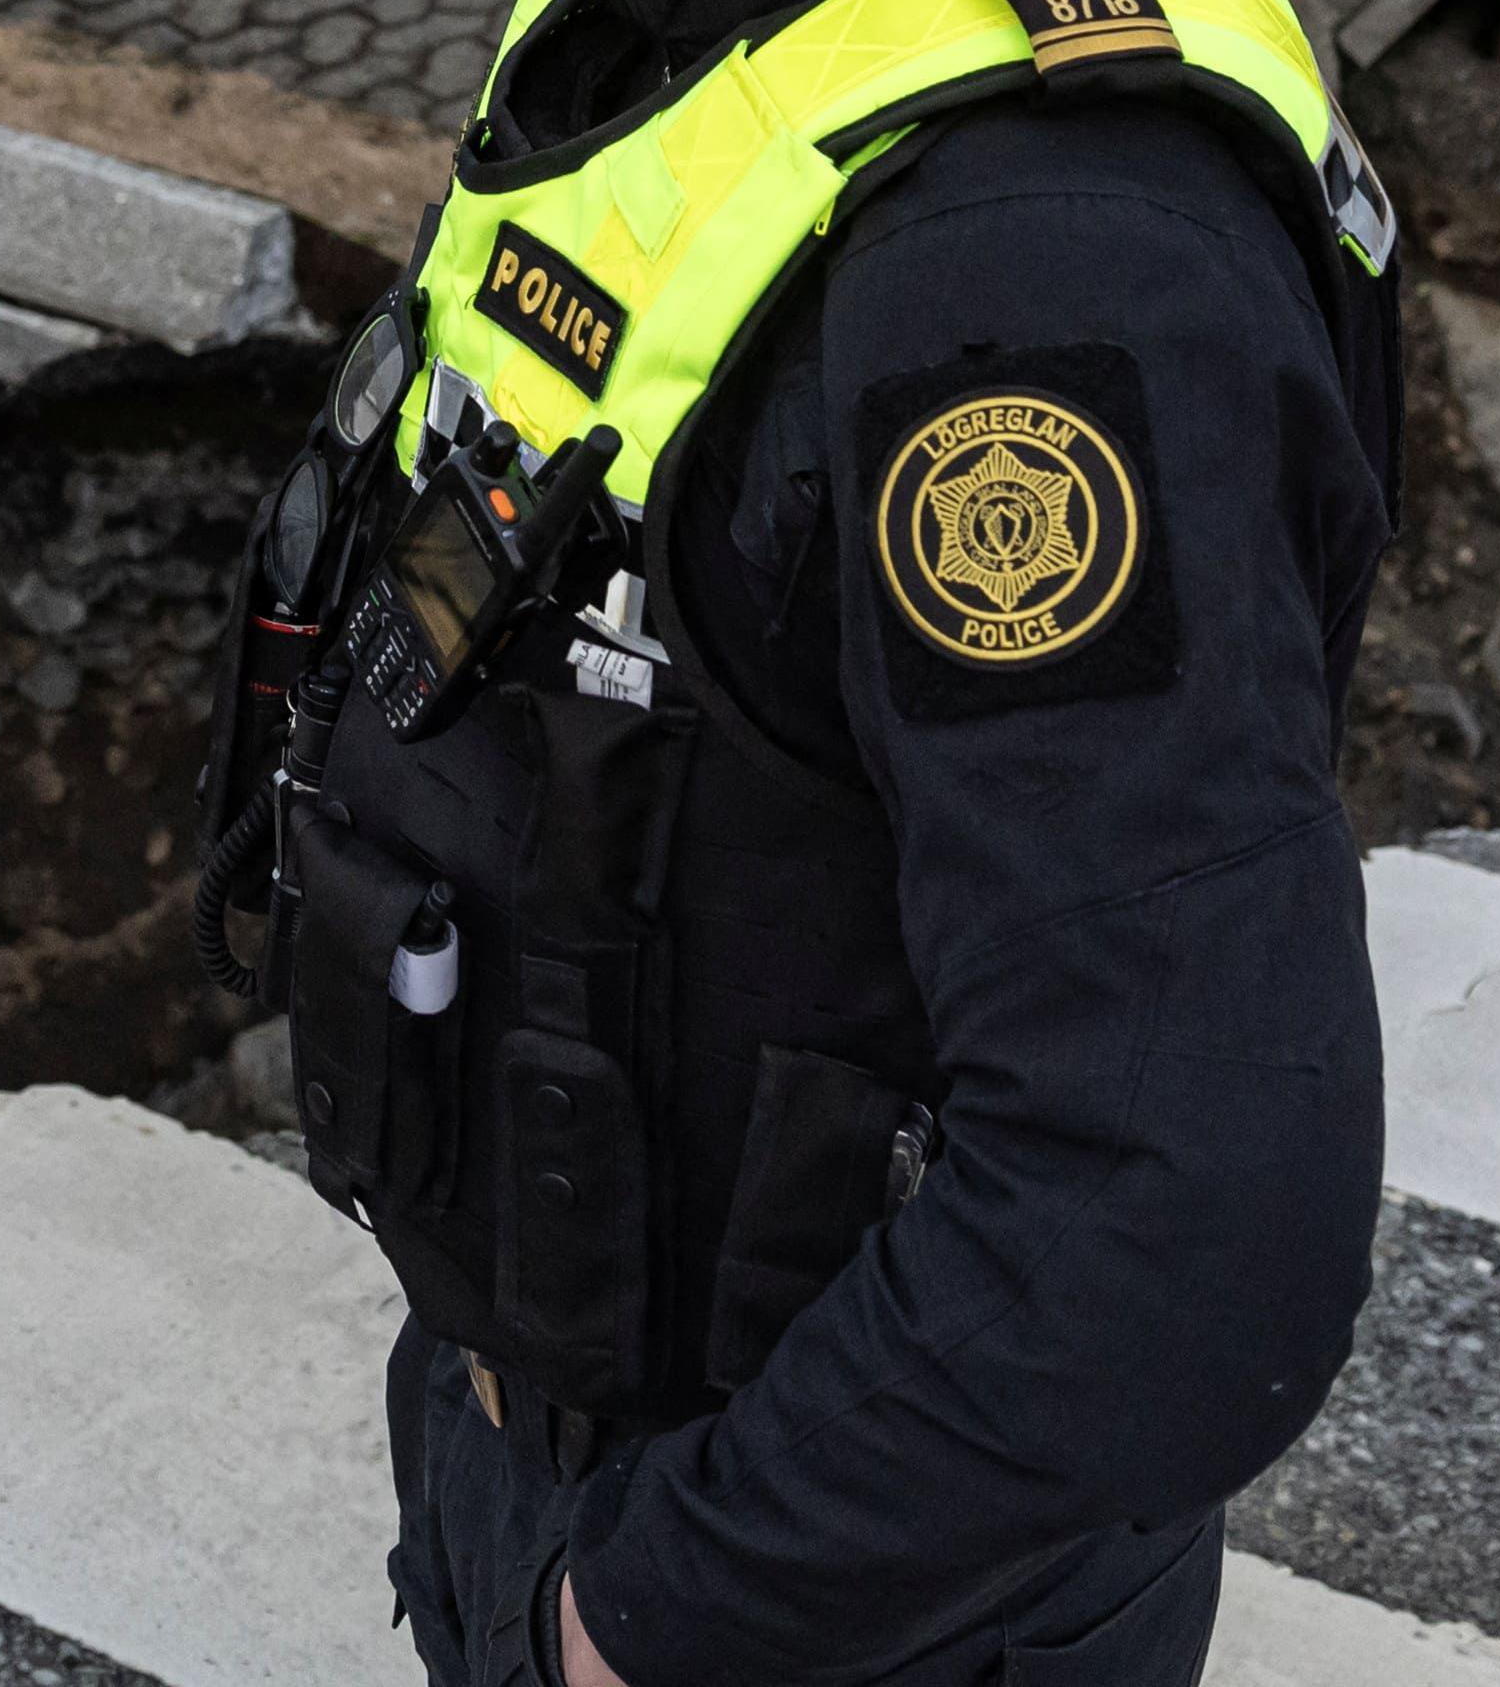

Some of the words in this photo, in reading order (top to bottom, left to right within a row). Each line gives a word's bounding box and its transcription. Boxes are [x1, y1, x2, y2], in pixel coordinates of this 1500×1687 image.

[491, 248, 612, 371] POLICE
[921, 408, 1077, 461] LÖGREGLAN
[962, 611, 1062, 648] POLICE
